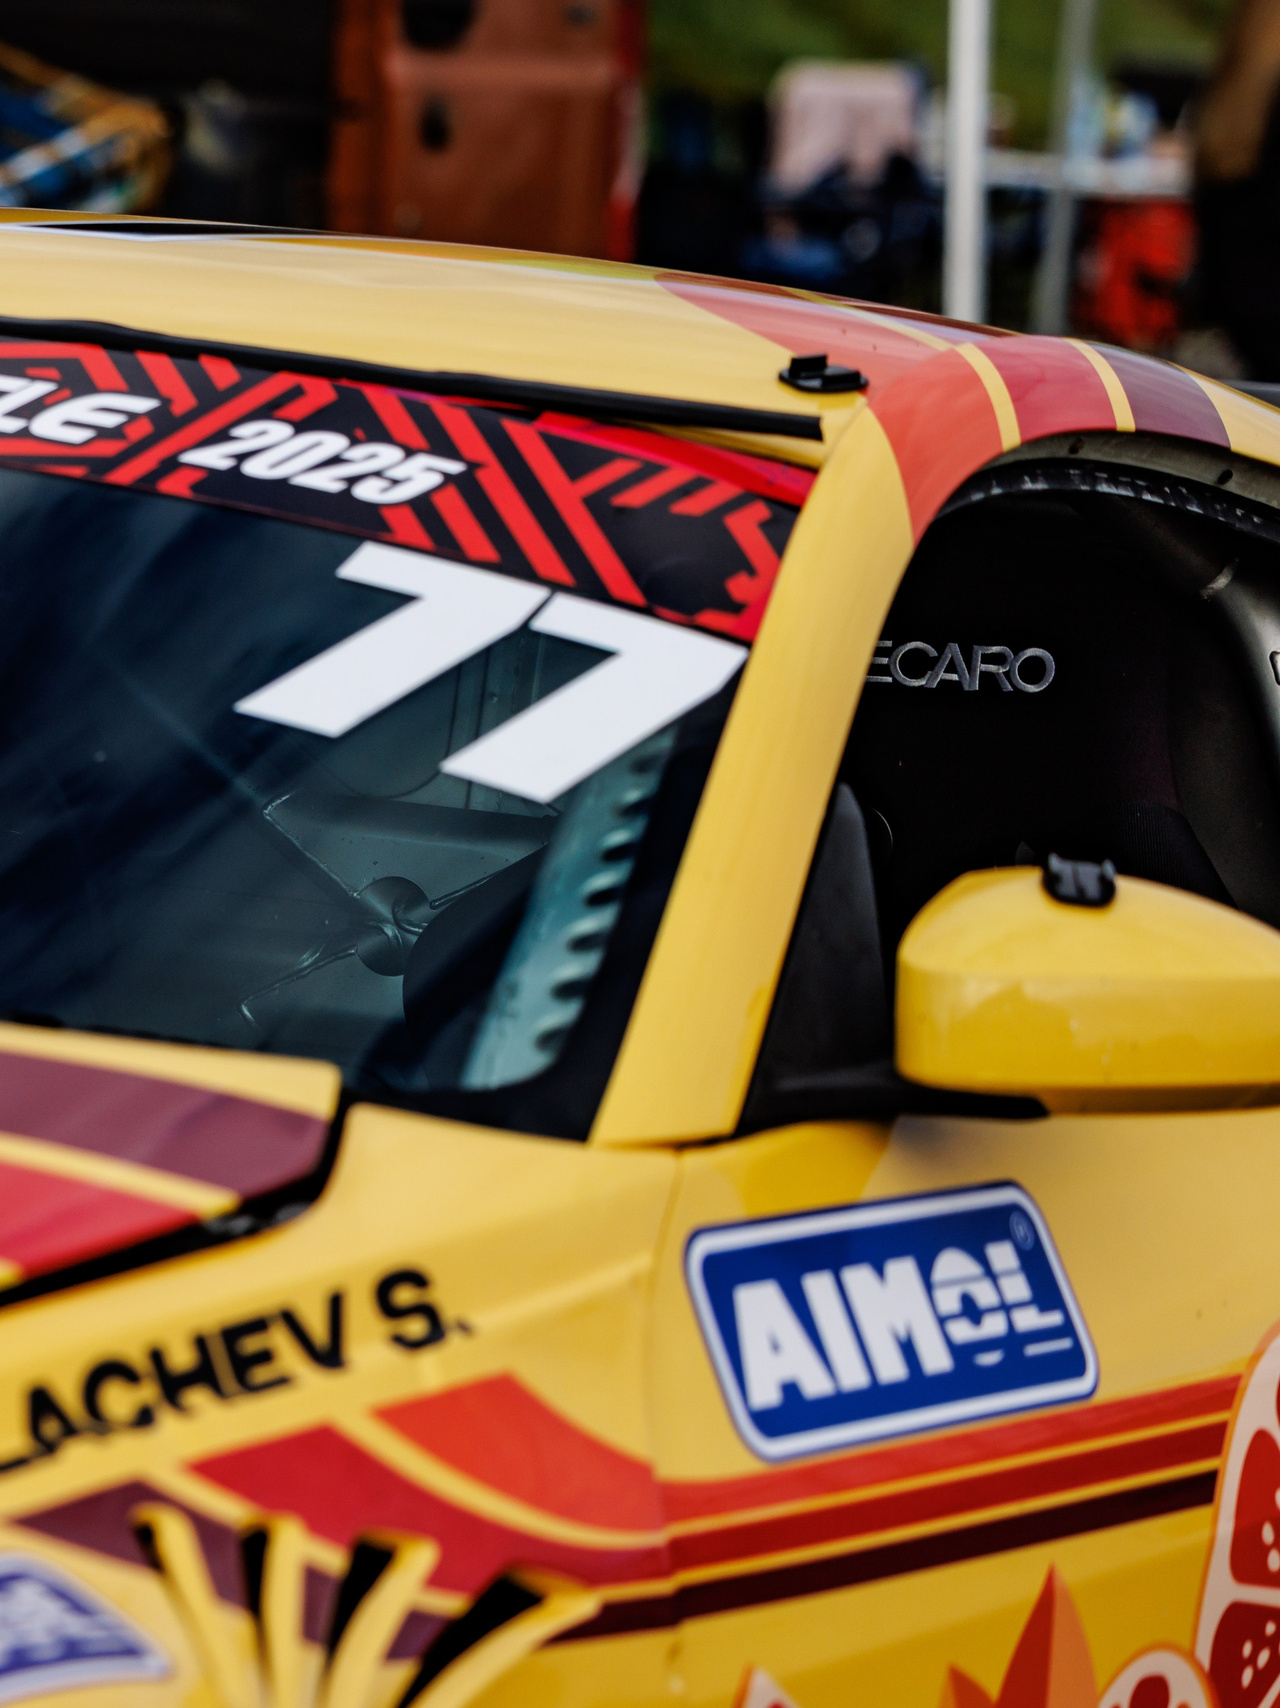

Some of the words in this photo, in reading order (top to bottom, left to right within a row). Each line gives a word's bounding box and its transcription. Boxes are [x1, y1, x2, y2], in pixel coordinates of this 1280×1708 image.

[178, 420, 468, 504] 2025
[234, 541, 749, 804] 77
[866, 640, 1055, 692] ECARO
[733, 1240, 1073, 1411] AIMOL
